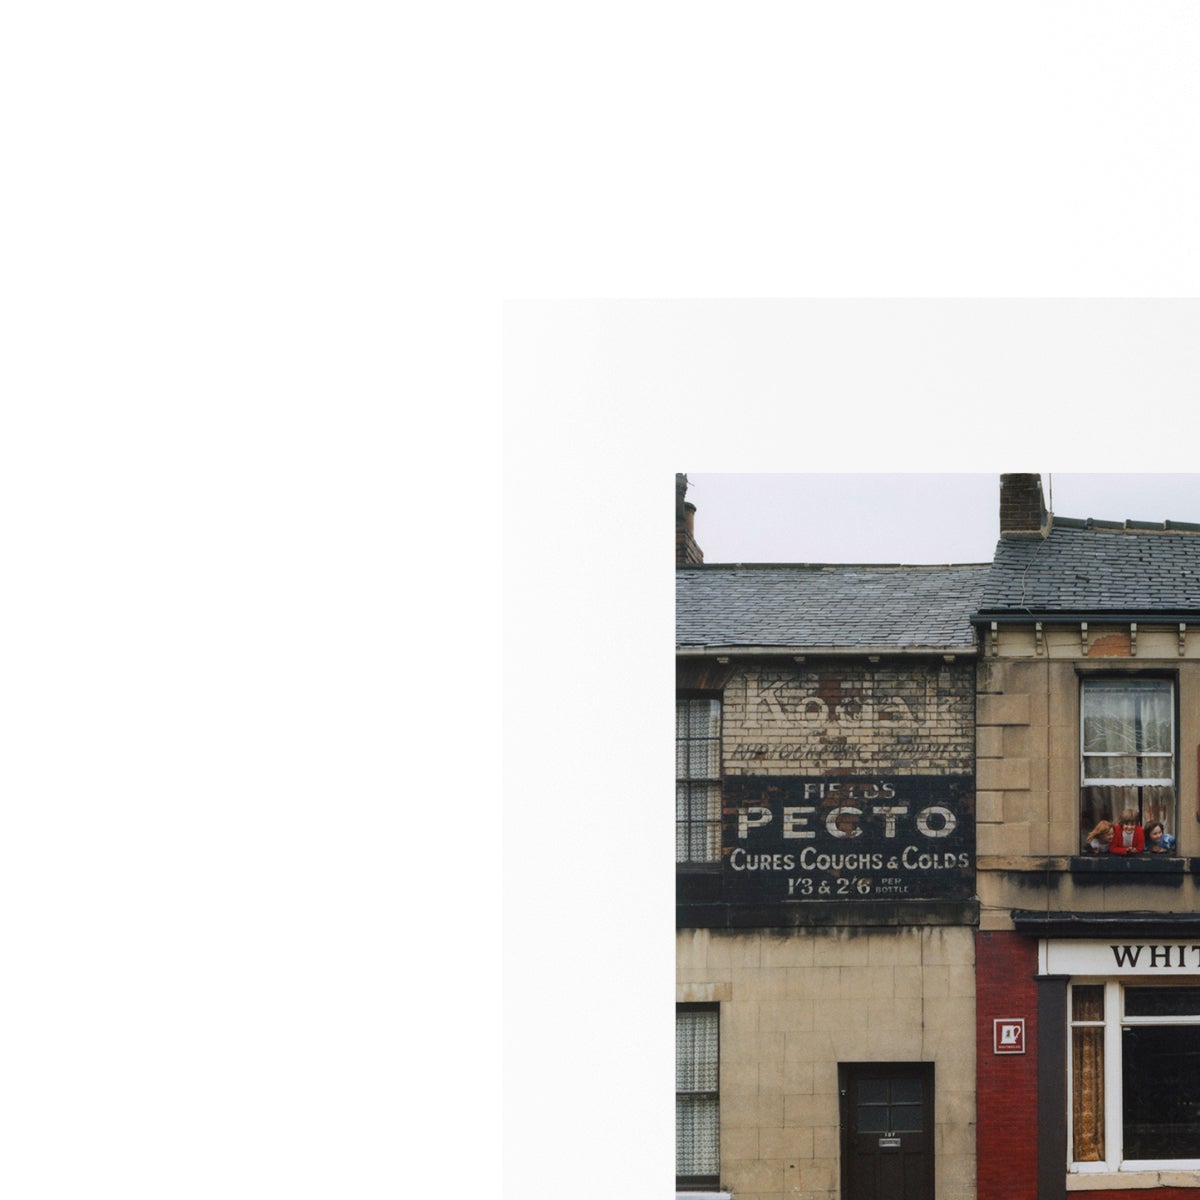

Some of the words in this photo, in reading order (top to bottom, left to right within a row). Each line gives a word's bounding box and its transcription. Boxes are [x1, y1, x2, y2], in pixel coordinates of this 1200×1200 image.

[737, 806, 957, 839] PECTO
[730, 847, 796, 871] CURES
[800, 846, 883, 871] COUGHS
[886, 856, 899, 870] &
[902, 845, 970, 870] COLDS
[818, 879, 831, 895] &
[881, 877, 902, 885] PER
[876, 886, 909, 894] BOTTLE
